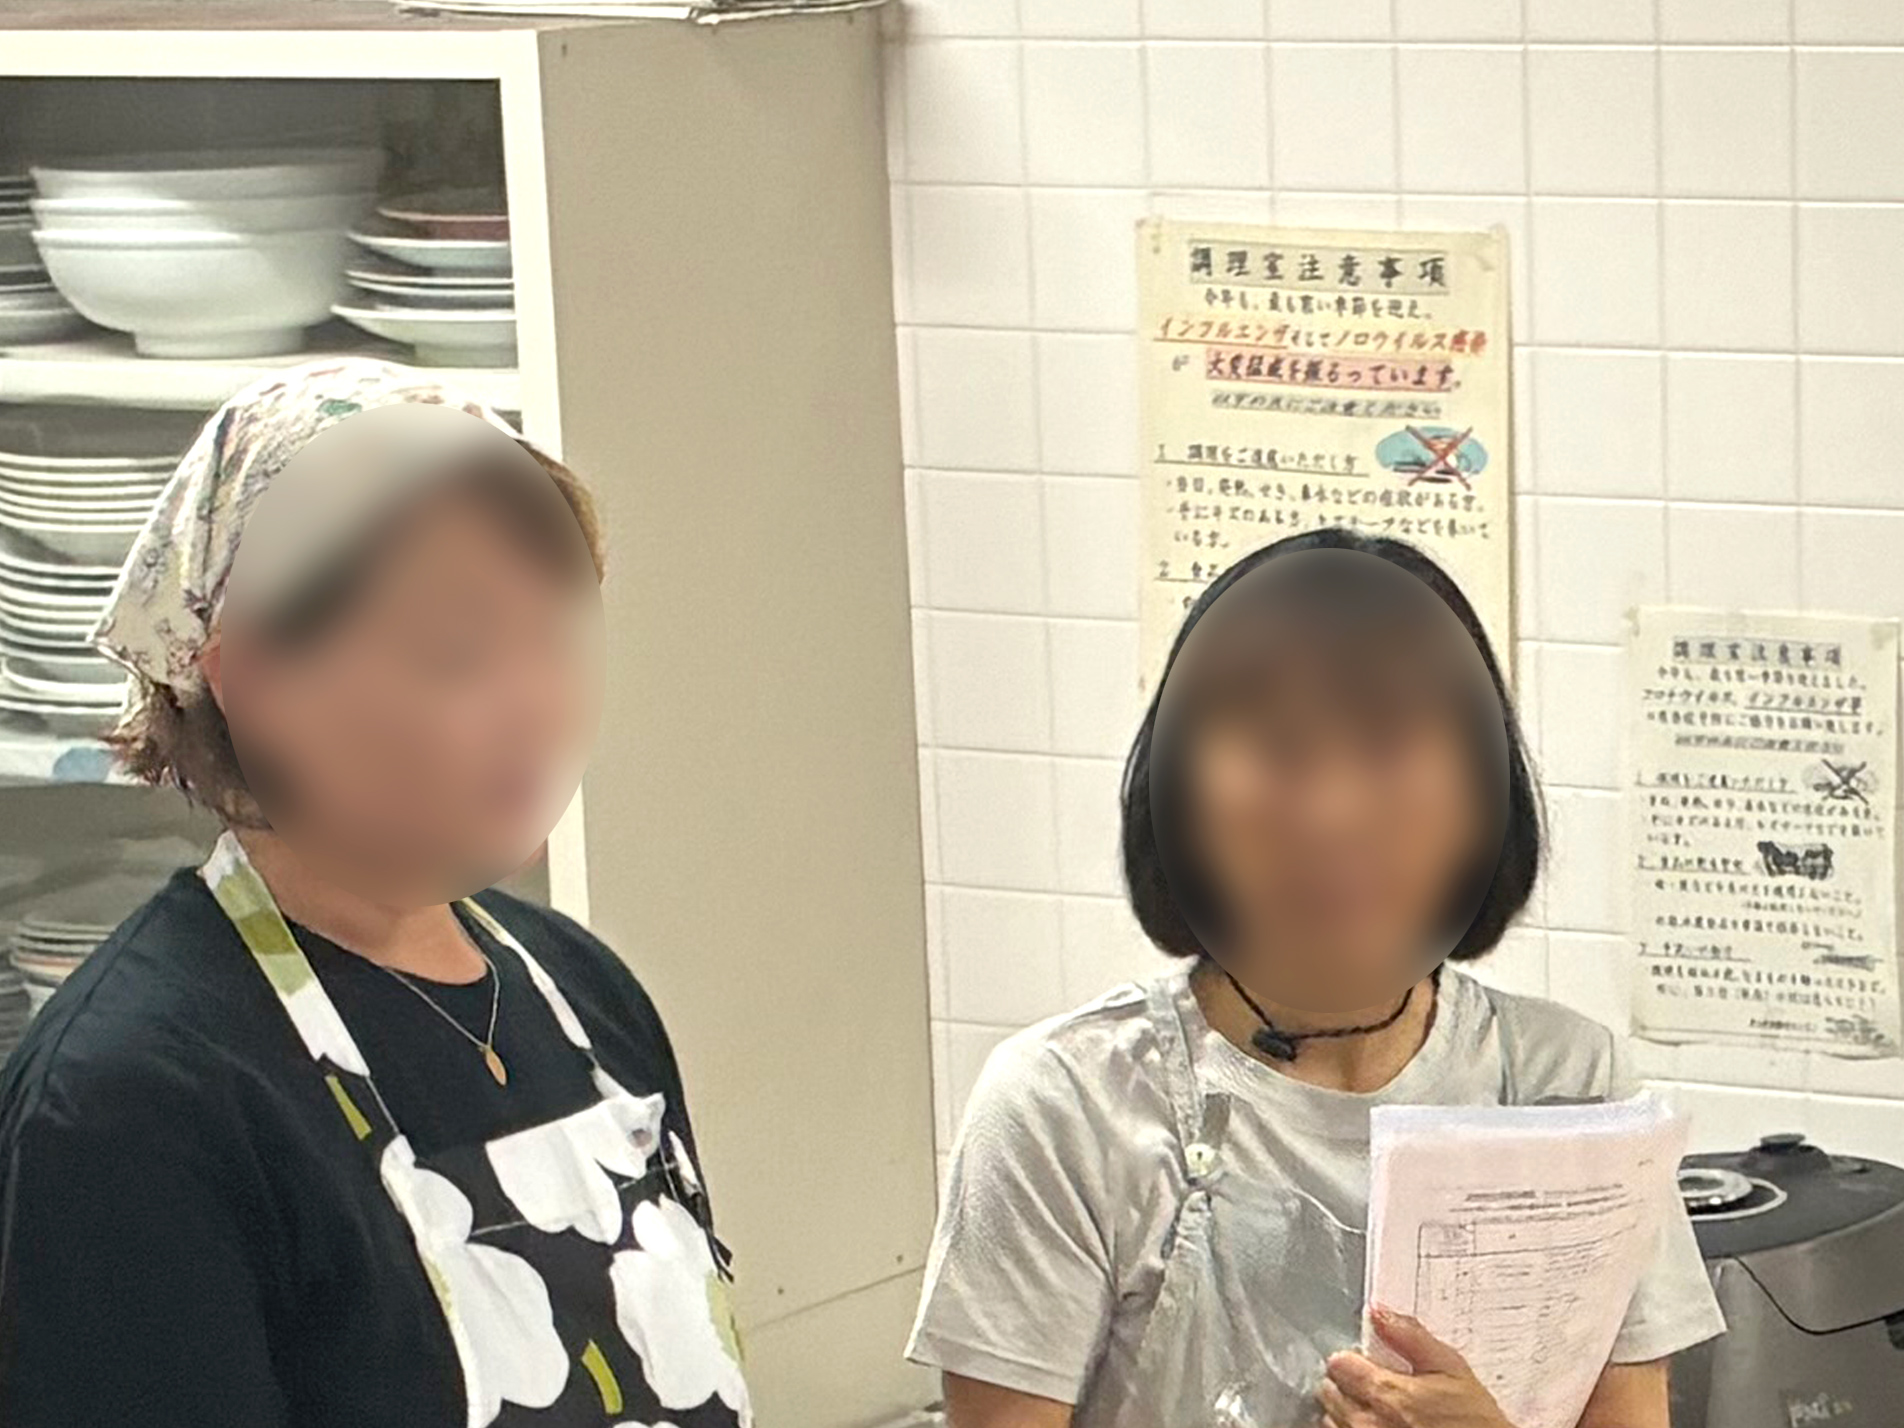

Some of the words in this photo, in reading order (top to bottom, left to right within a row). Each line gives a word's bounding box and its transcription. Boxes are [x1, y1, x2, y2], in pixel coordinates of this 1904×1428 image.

[1189, 246, 1449, 288] 調理室注意事項
